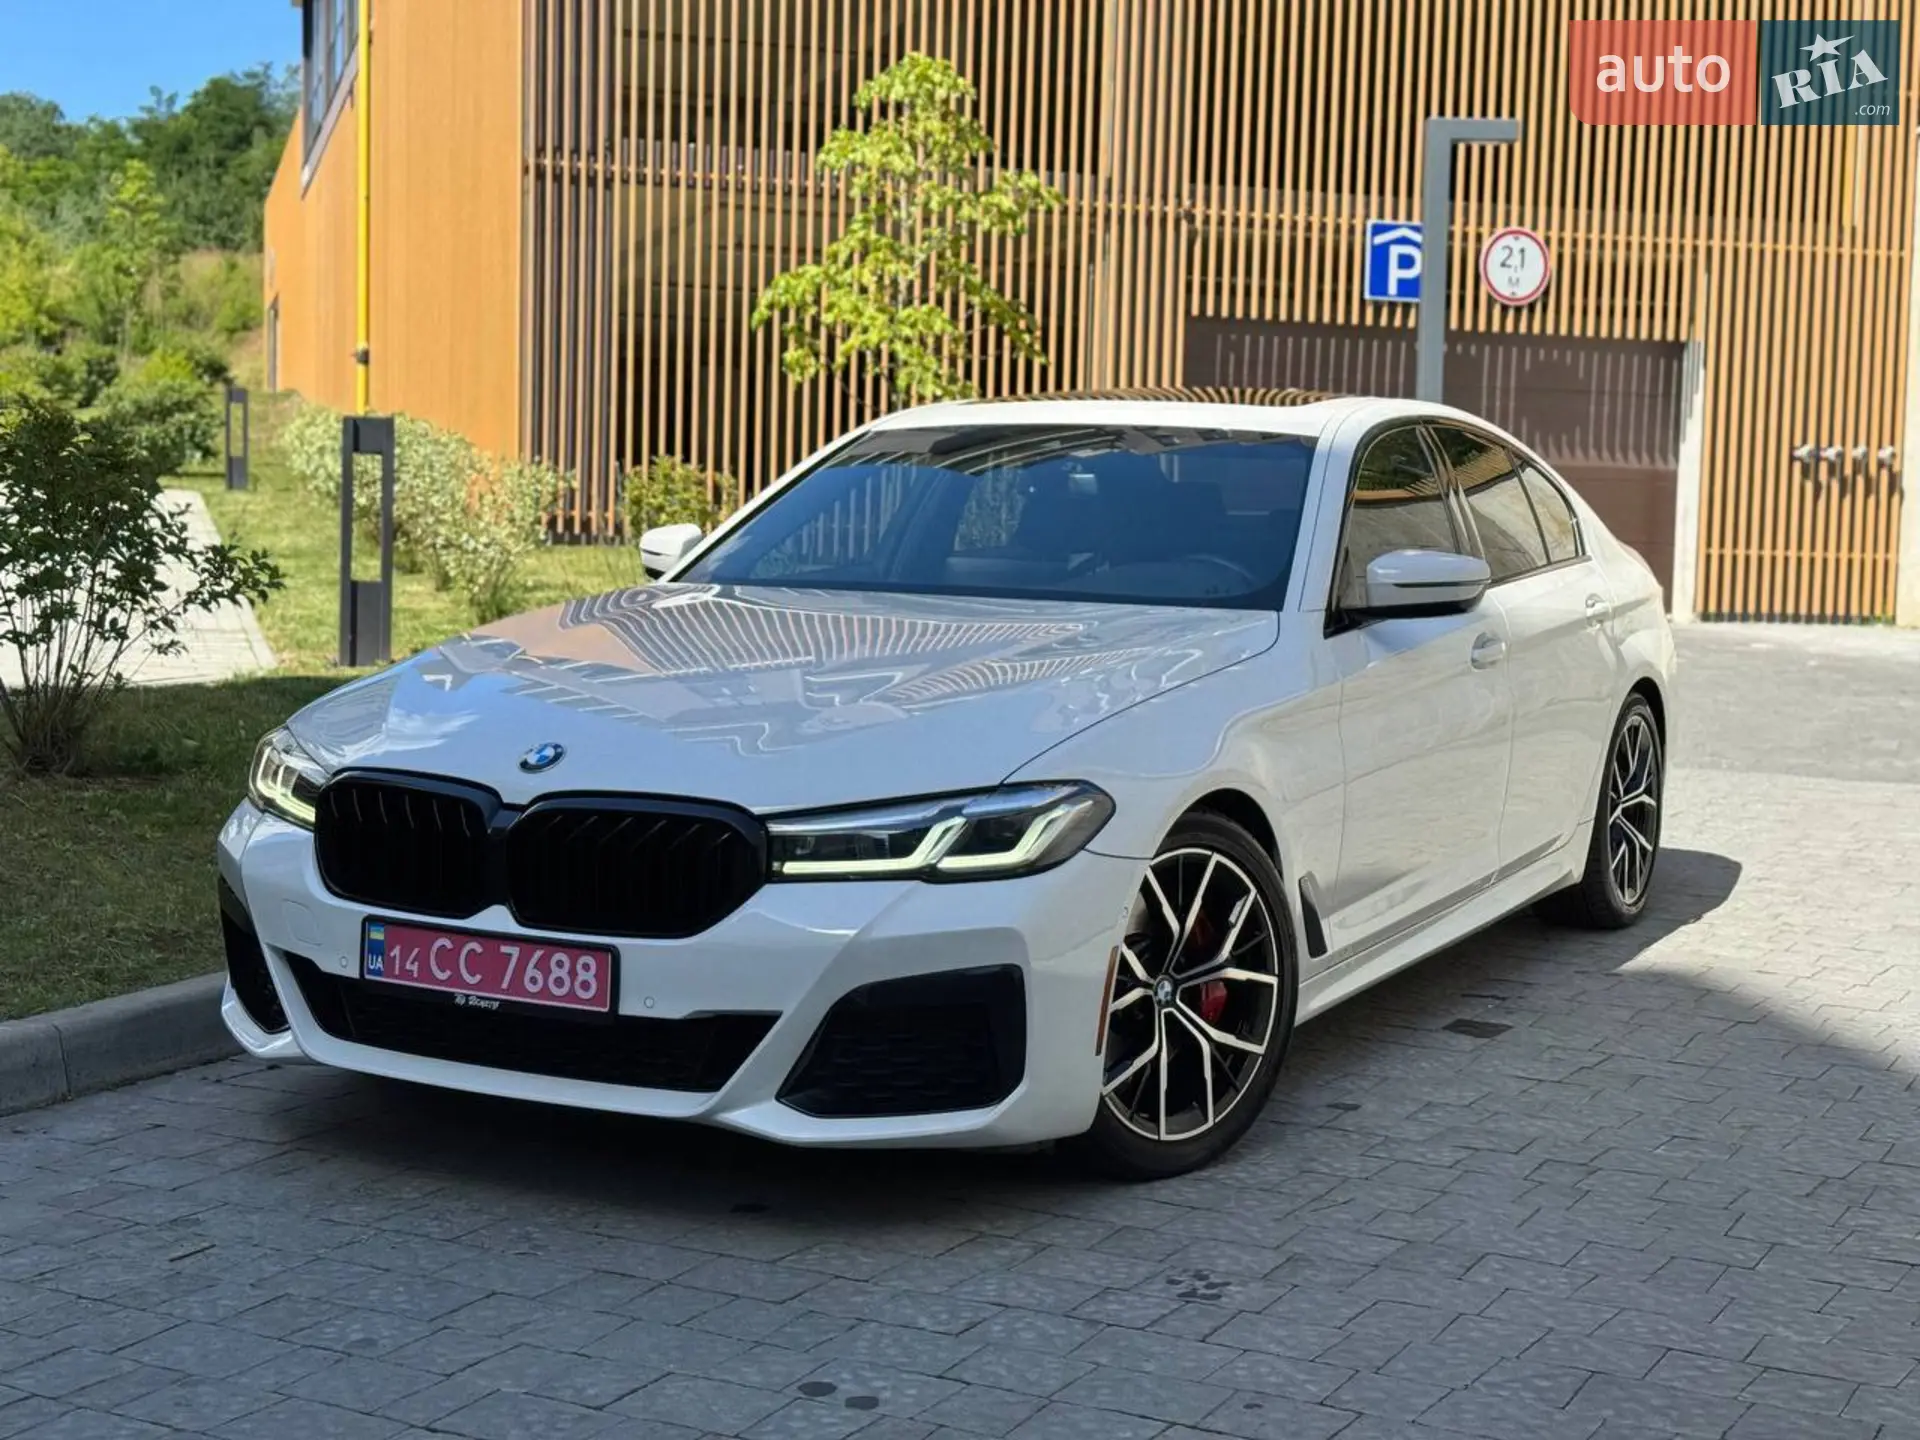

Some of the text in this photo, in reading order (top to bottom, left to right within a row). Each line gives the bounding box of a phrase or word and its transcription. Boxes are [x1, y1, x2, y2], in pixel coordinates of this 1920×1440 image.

[1387, 244, 1422, 296] P
[1500, 244, 1526, 273] 2,1
[368, 953, 385, 972] UA
[389, 937, 598, 1000] 14 CC 7688
